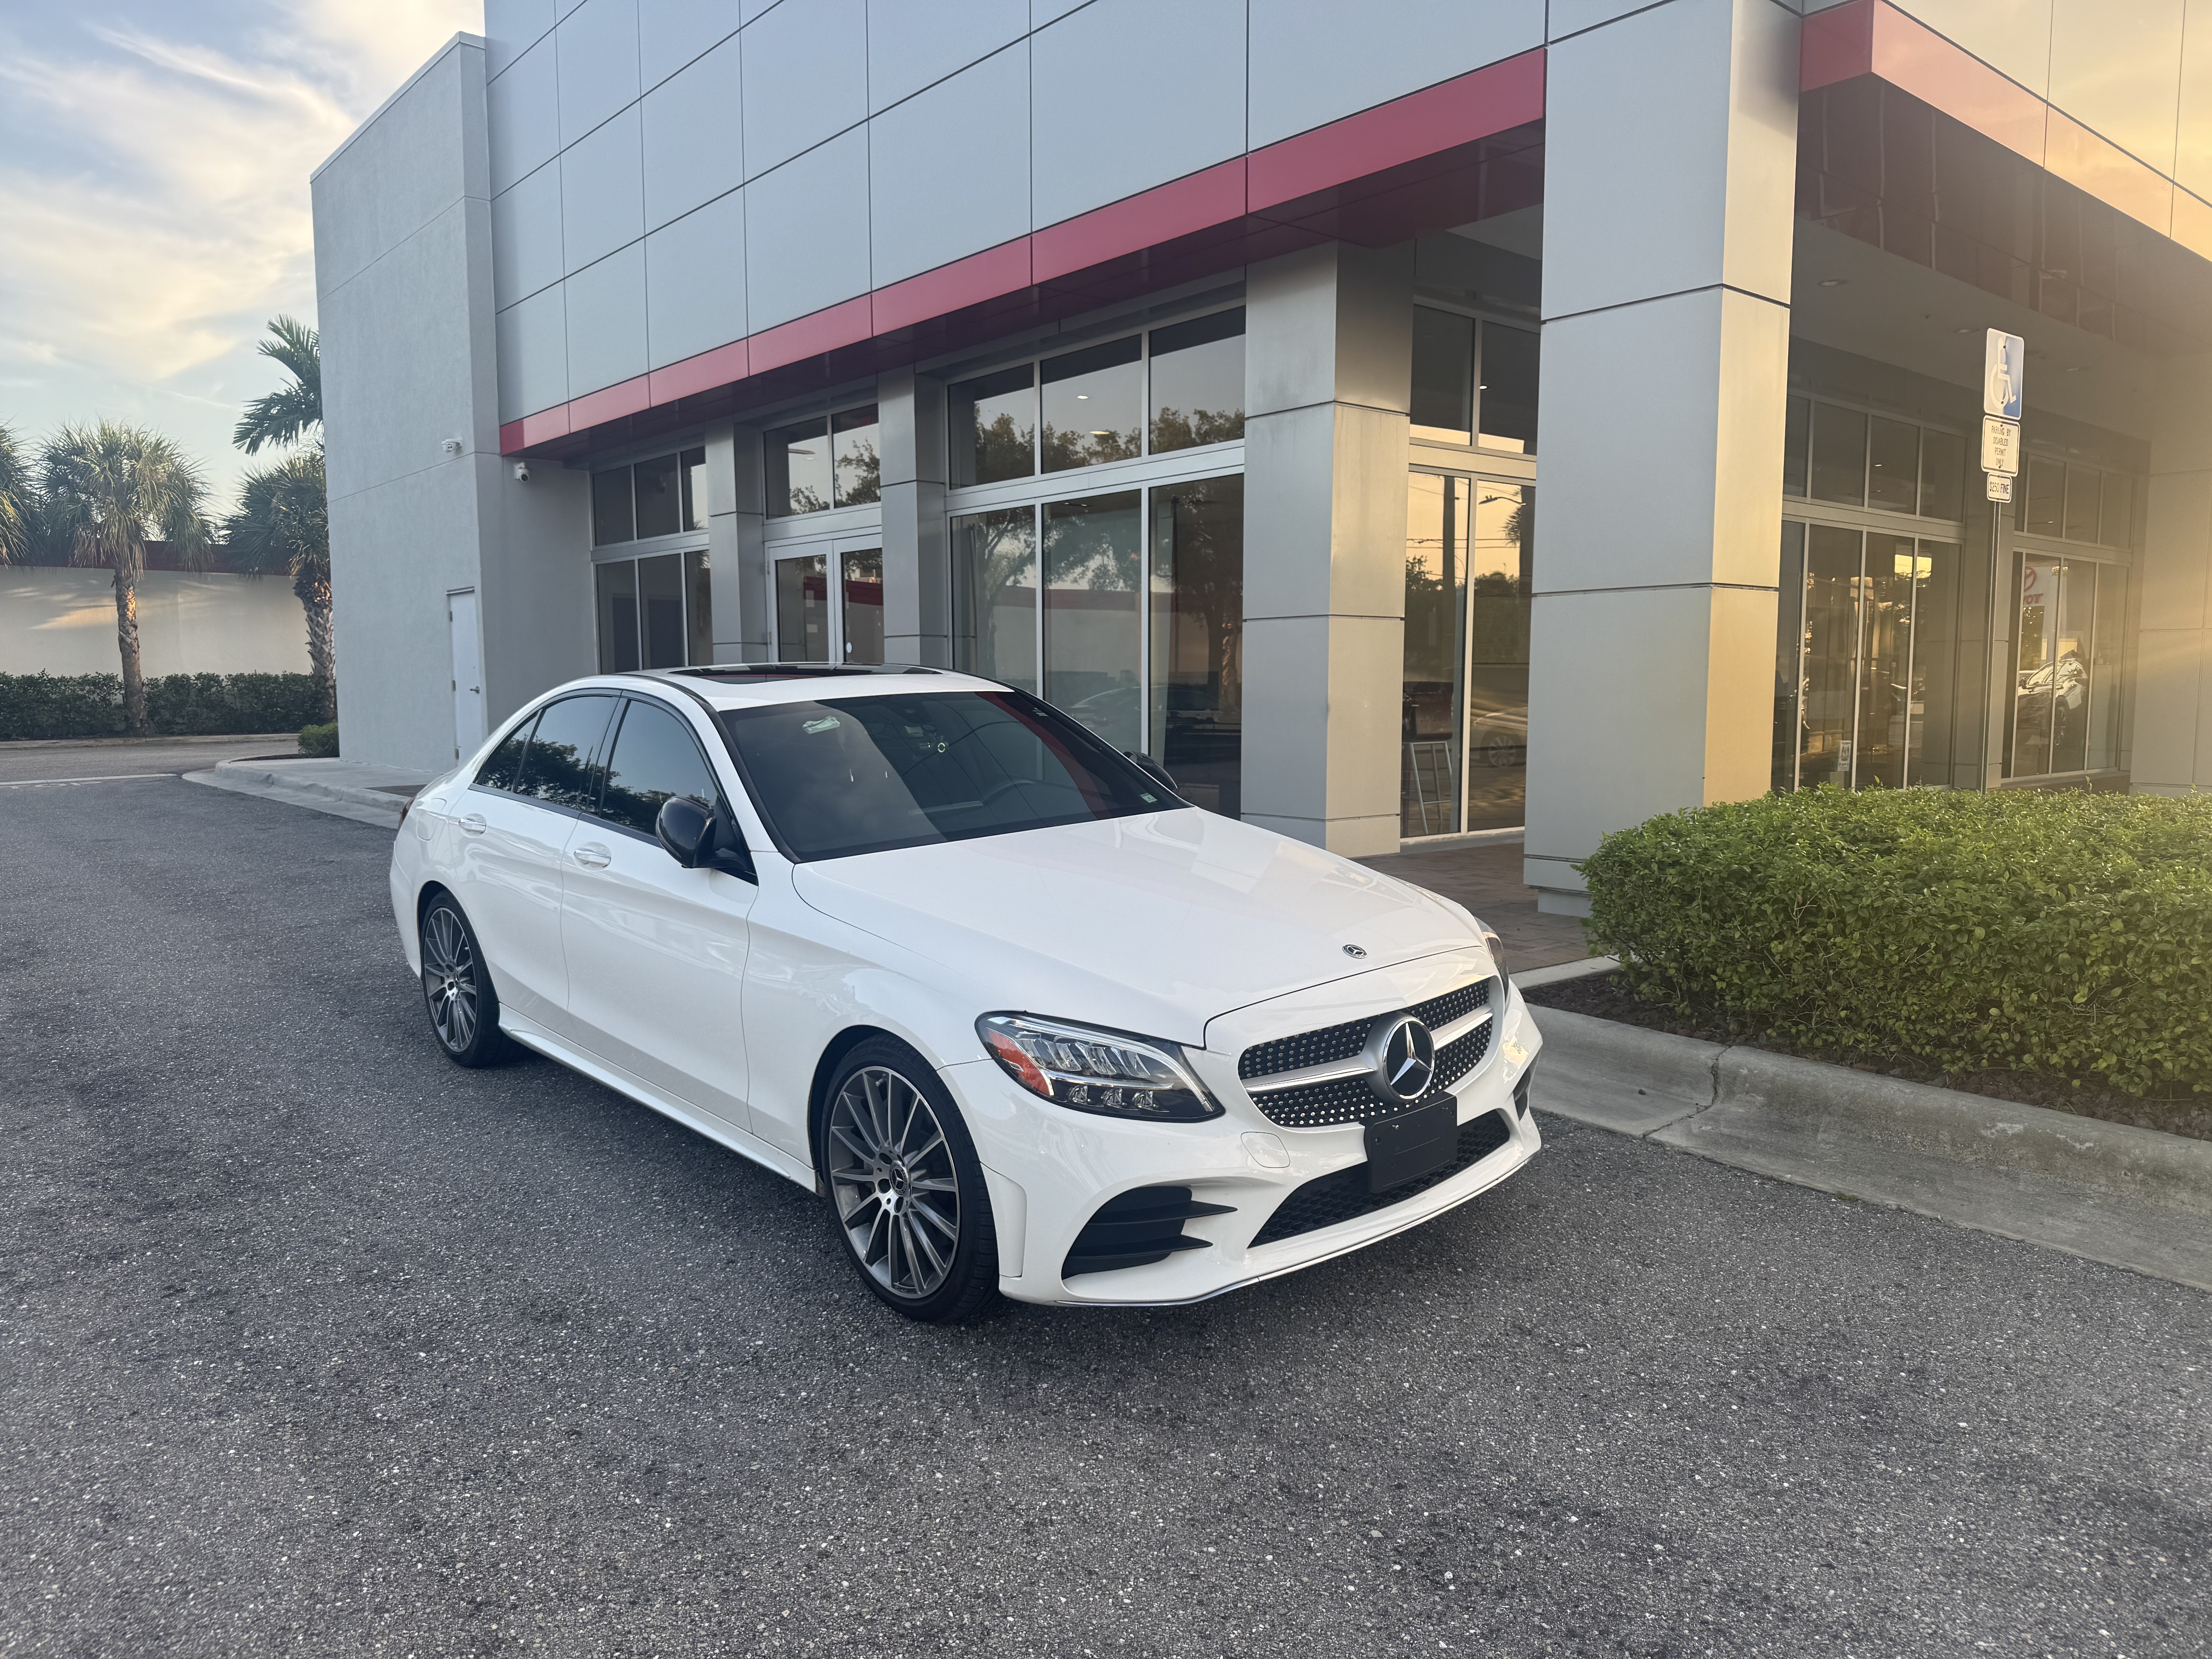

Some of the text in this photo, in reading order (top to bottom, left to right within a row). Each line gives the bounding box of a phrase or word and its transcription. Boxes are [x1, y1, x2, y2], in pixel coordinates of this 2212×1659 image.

[1991, 426, 2004, 435] PARKING
[1993, 436, 2009, 446] DISABLED
[1995, 447, 2006, 456] PERMIT
[1996, 458, 2004, 466] ONLY
[1990, 481, 2009, 494] $250 FINE
